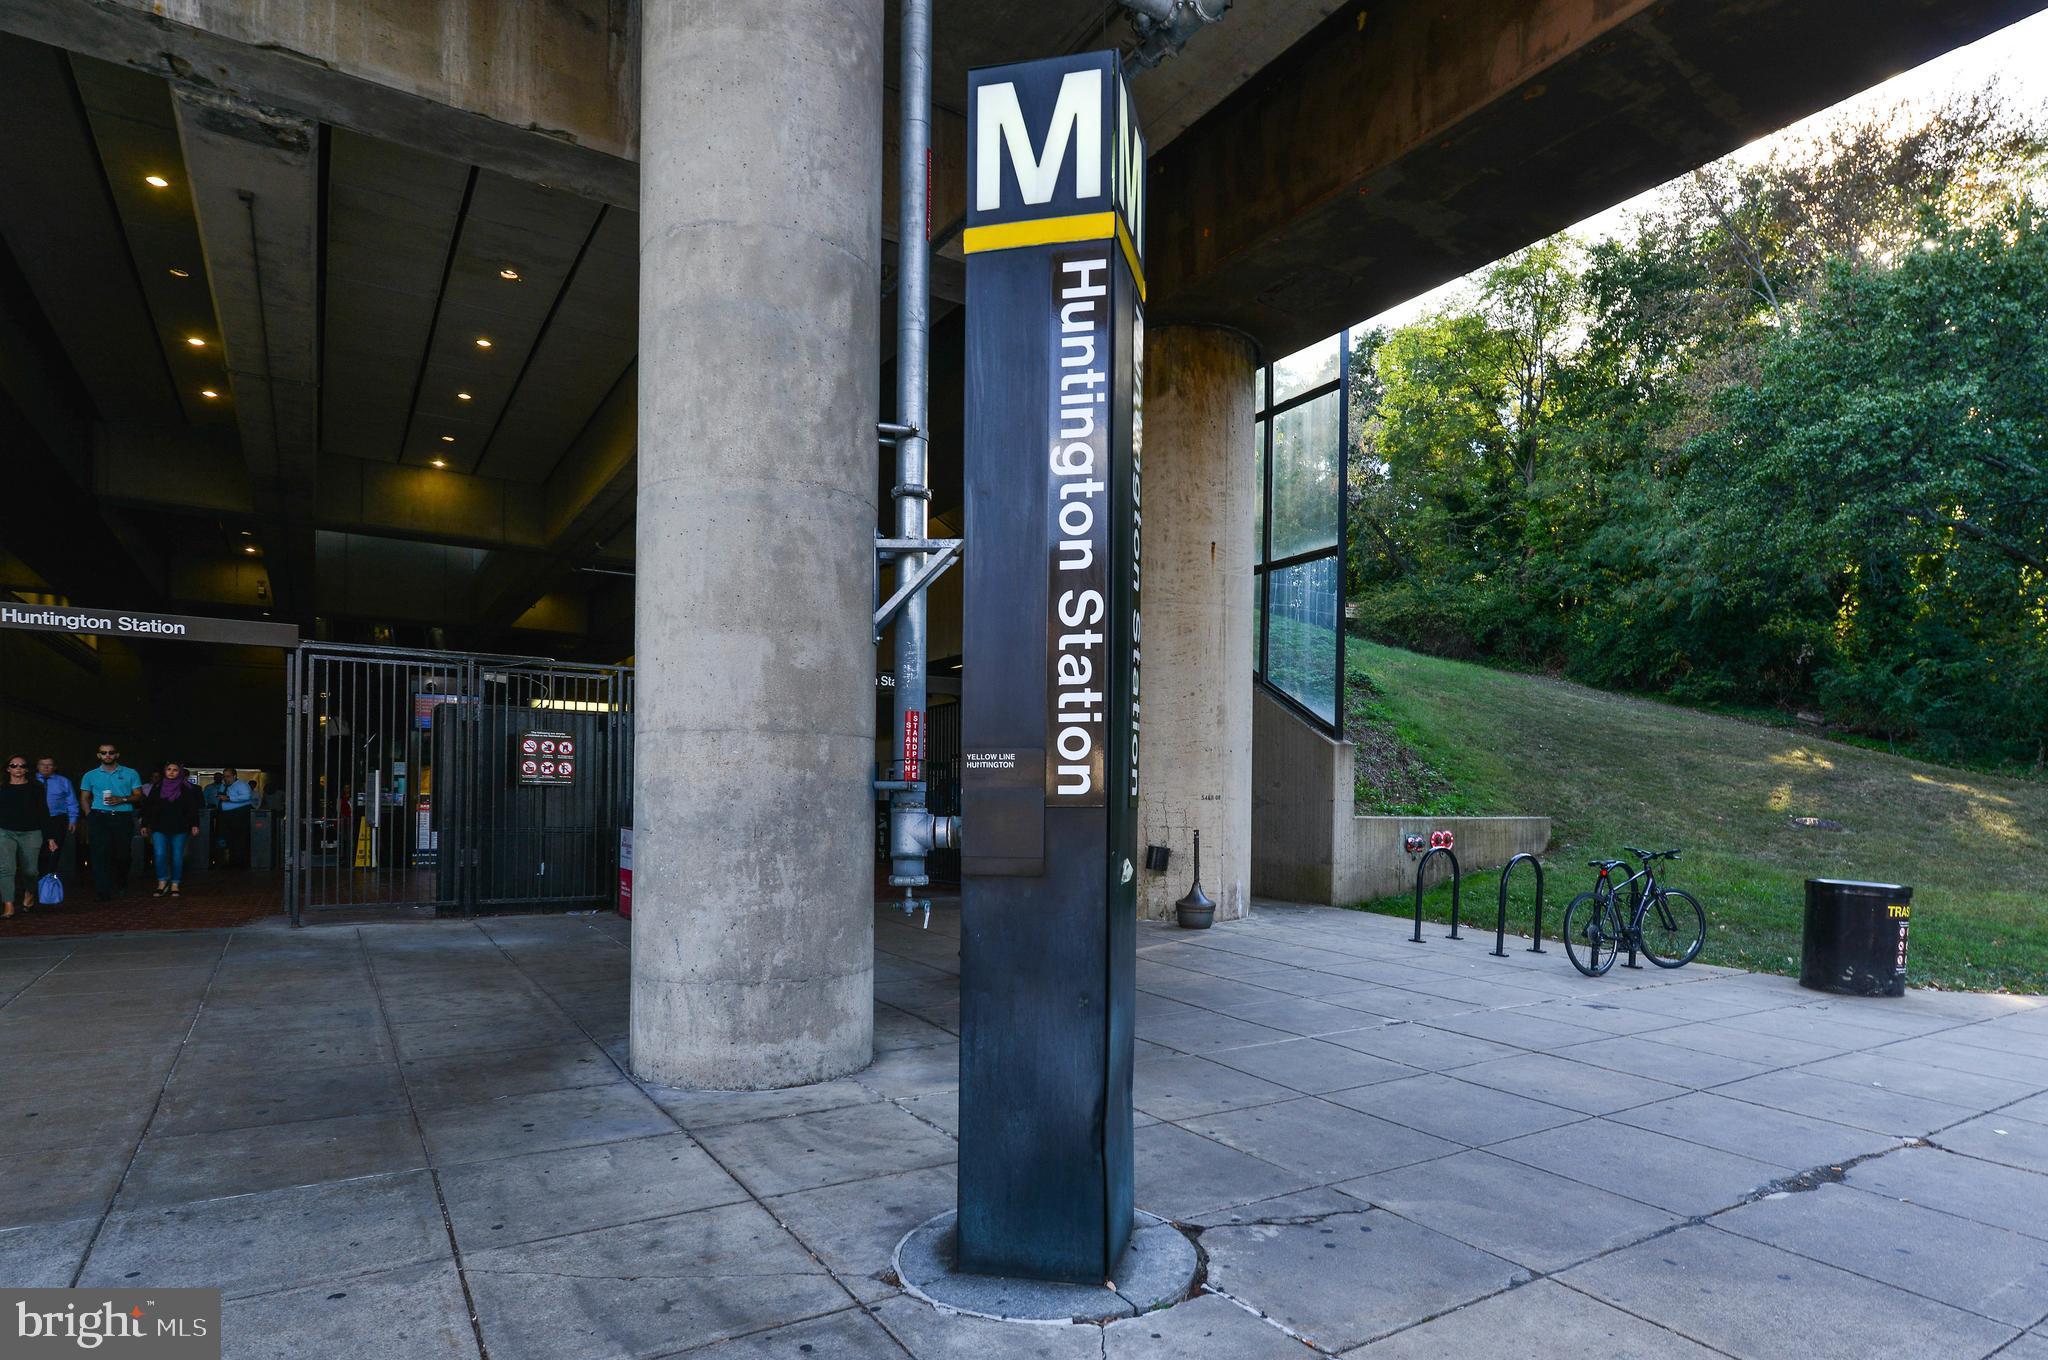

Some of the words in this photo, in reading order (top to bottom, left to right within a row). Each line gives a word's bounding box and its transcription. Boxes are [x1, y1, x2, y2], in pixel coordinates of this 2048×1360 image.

[977, 68, 1102, 212] M
[1118, 72, 1143, 259] M
[1050, 258, 1107, 571] Huntington
[1, 607, 112, 630] Huntington
[118, 616, 186, 635] Station
[880, 675, 895, 687] Sta
[1057, 589, 1105, 795] Station
[1131, 608, 1142, 796] Station
[966, 753, 998, 761] YELLOW
[998, 753, 1016, 761] LINE
[966, 761, 1015, 769] HUNTINGTON
[1888, 905, 1910, 917] TRAS
